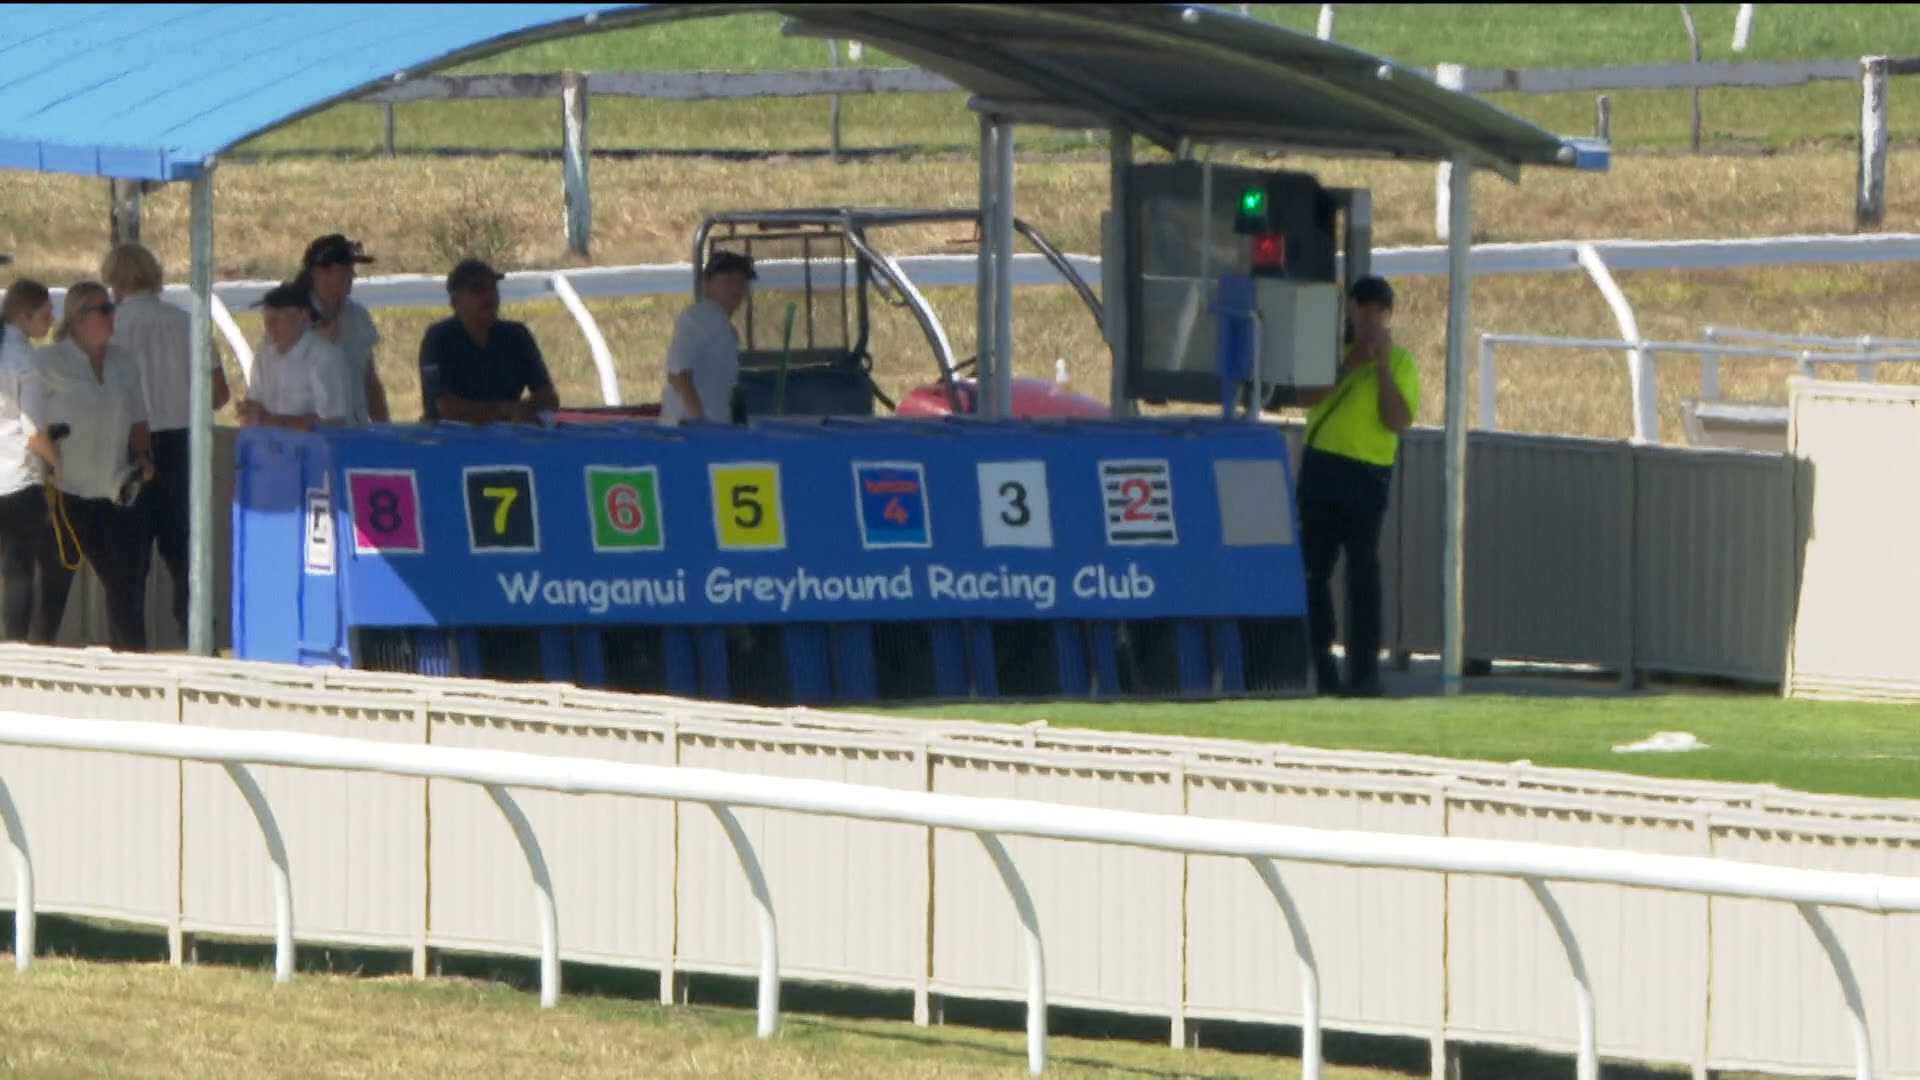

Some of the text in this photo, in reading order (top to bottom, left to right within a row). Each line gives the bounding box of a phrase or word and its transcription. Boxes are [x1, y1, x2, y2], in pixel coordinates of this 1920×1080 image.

[369, 488, 403, 534] 8
[482, 486, 519, 534] 7
[605, 485, 646, 533] 6
[730, 485, 764, 529] 5
[884, 495, 909, 526] 4
[999, 480, 1031, 527] 3
[1120, 478, 1154, 522] 2
[496, 563, 1156, 614] Wanganui Greyhound Racing Club
